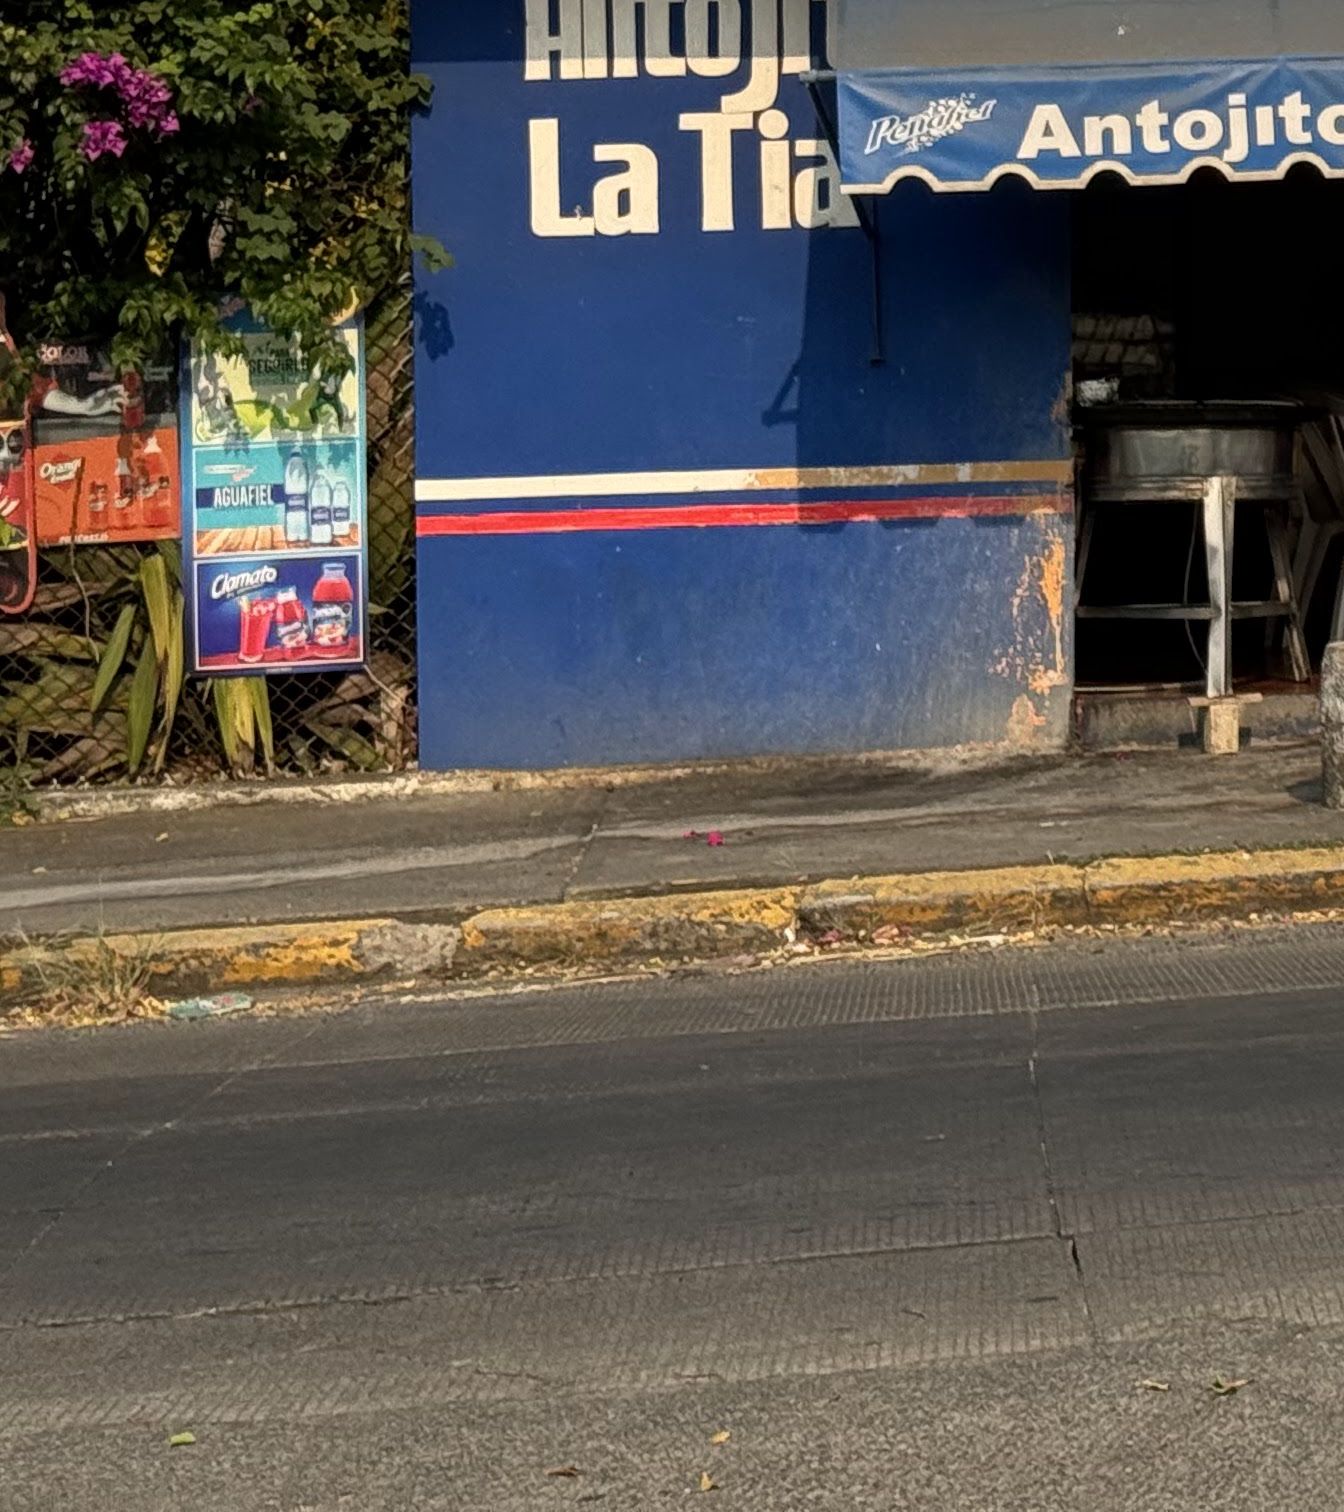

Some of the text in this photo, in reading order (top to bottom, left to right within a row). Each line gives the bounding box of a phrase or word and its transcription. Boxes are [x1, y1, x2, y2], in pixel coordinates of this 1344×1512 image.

[528, 109, 862, 237] La Tia
[213, 484, 275, 509] AGUAFIEL
[211, 564, 278, 600] Clamato
